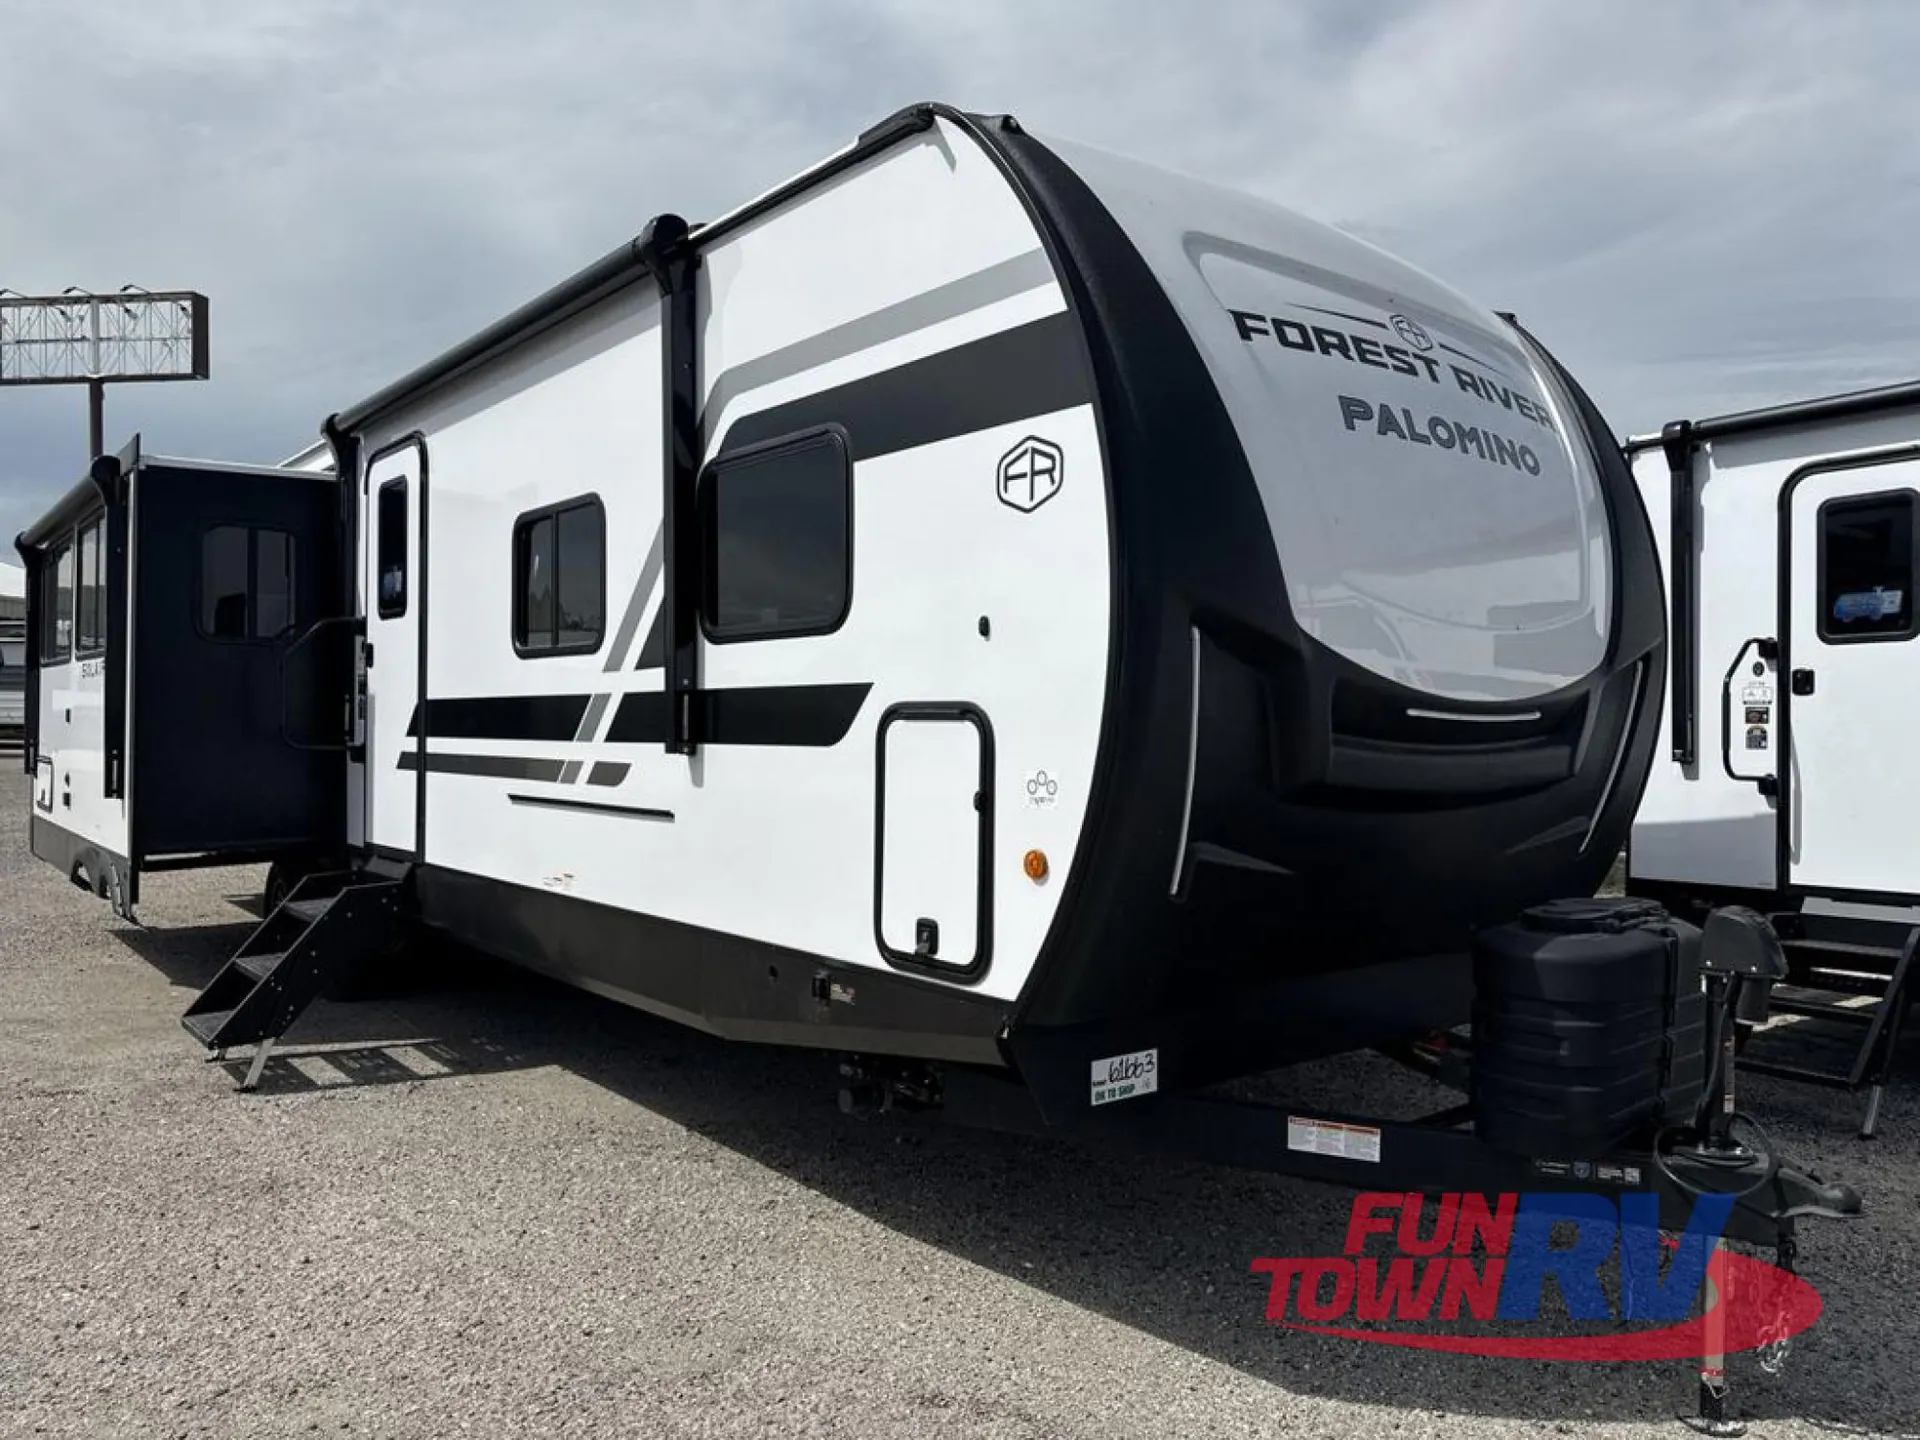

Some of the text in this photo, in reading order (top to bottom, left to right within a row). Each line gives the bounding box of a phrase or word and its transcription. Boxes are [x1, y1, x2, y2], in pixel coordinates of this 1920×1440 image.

[1228, 309, 1558, 432] FOREST RIVER
[1338, 395, 1541, 477] PALOMINO
